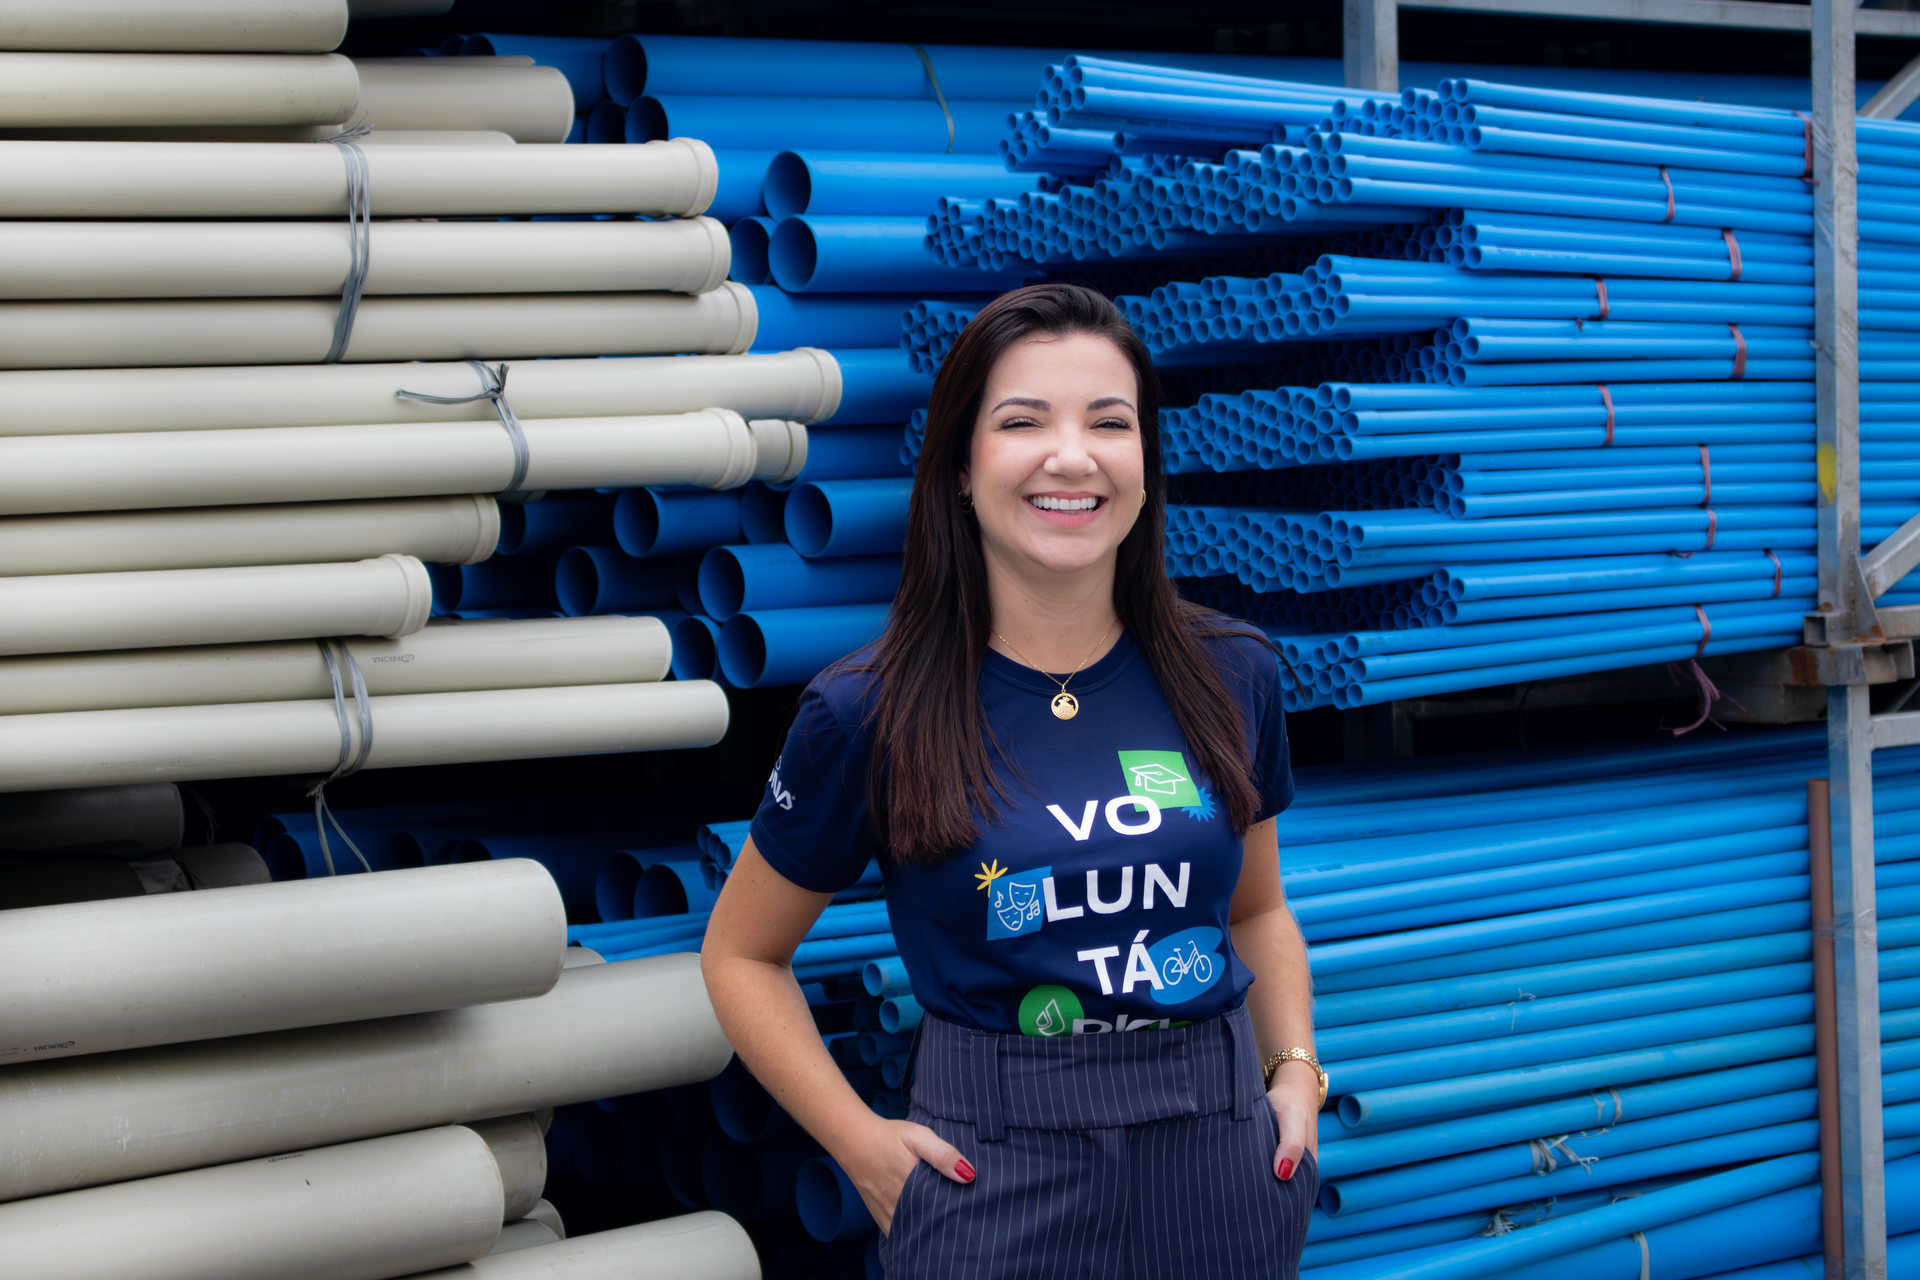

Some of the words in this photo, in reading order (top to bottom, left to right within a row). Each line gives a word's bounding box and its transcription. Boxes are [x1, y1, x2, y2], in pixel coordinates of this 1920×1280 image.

[1046, 795, 1162, 842] VO
[1042, 862, 1191, 923] LUN
[1077, 929, 1165, 996] TÁ
